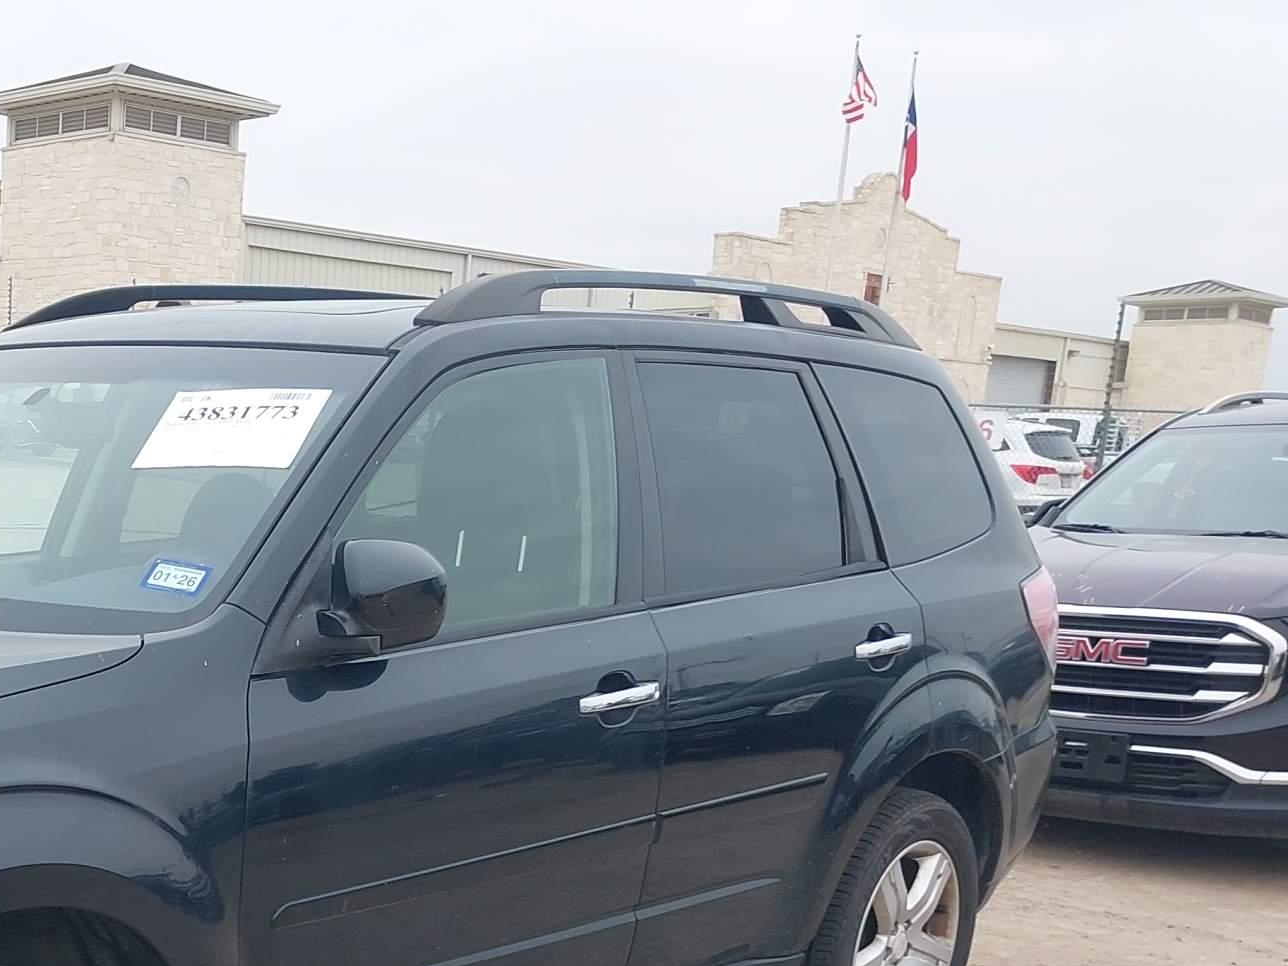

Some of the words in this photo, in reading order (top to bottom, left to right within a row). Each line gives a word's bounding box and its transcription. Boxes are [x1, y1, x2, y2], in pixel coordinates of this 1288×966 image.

[178, 405, 300, 421] 43831773
[152, 570, 171, 583] 01
[177, 574, 197, 588] 26
